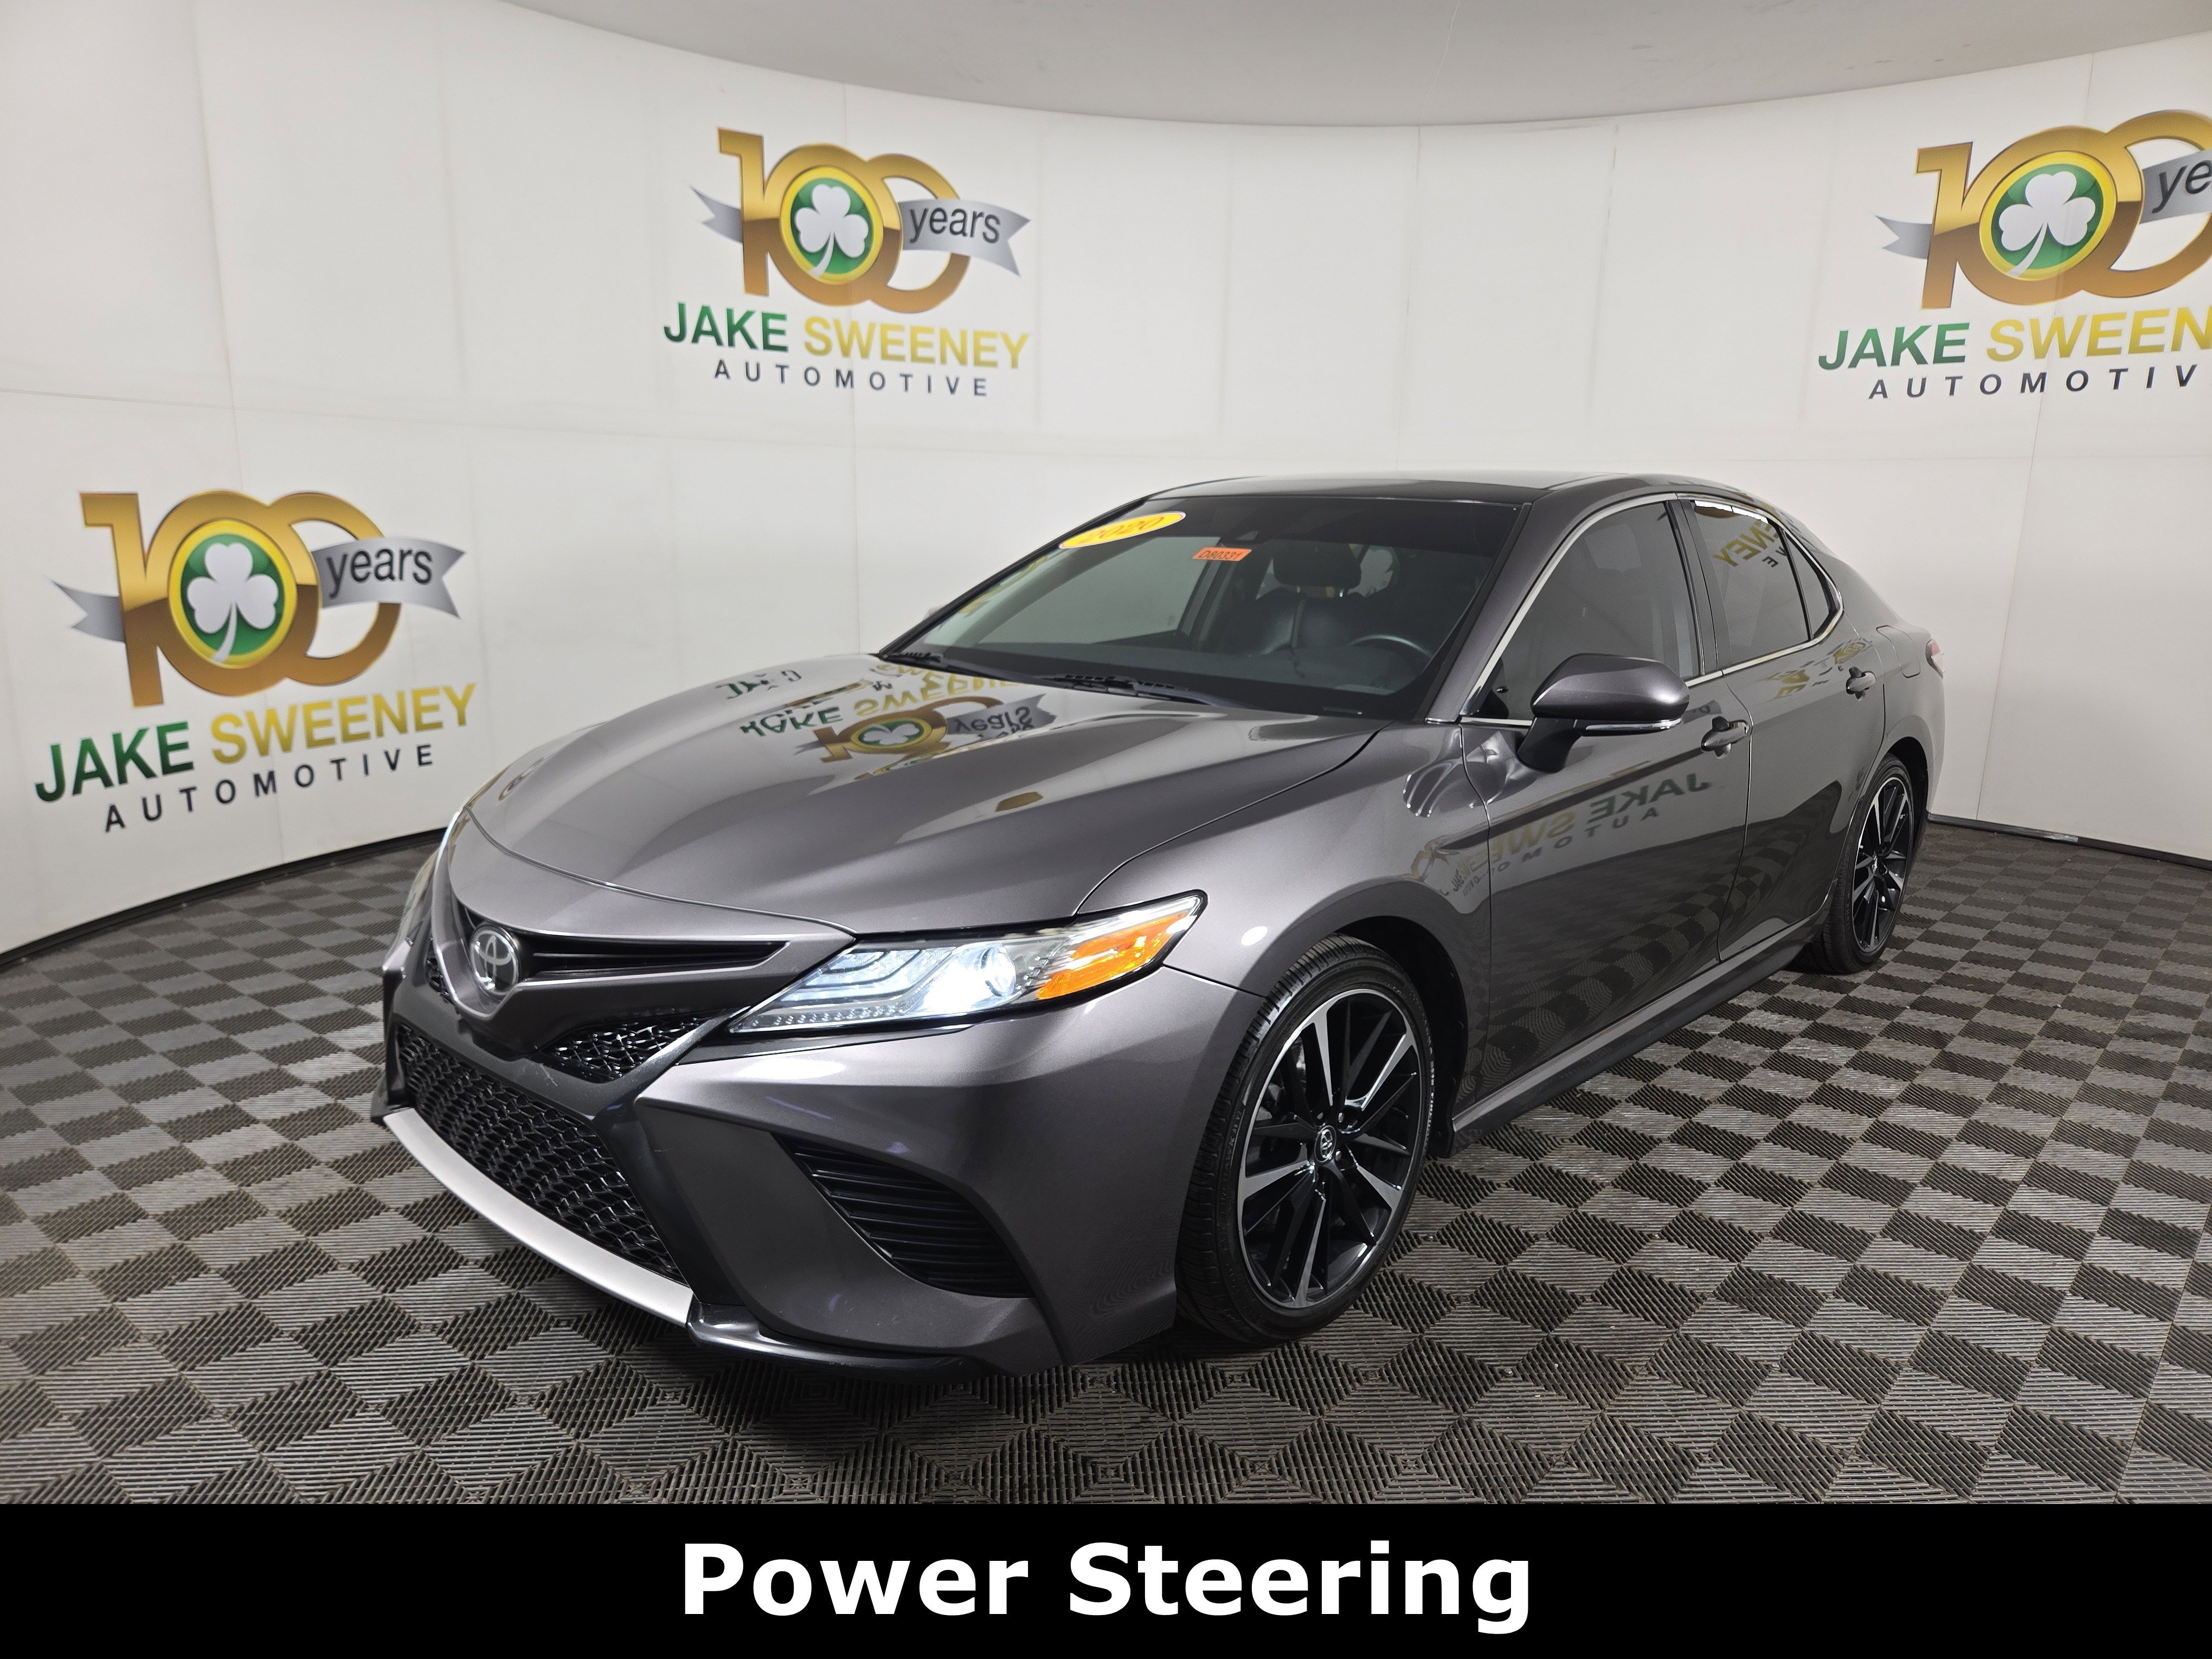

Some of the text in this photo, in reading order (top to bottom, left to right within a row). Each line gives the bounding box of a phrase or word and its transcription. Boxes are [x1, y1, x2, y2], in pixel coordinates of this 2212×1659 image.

[717, 127, 970, 313] 100
[909, 208, 1000, 244] years
[664, 301, 1030, 370] JAKE SWEENEY
[1818, 322, 1970, 370] JAKE
[713, 360, 987, 397] AUTOMOTIVE
[1078, 516, 1165, 544] 2020
[79, 490, 401, 708] 100
[325, 549, 434, 599] years
[34, 684, 476, 802] JAKE SWEENEY
[105, 744, 434, 833] AUTOMOTIVE
